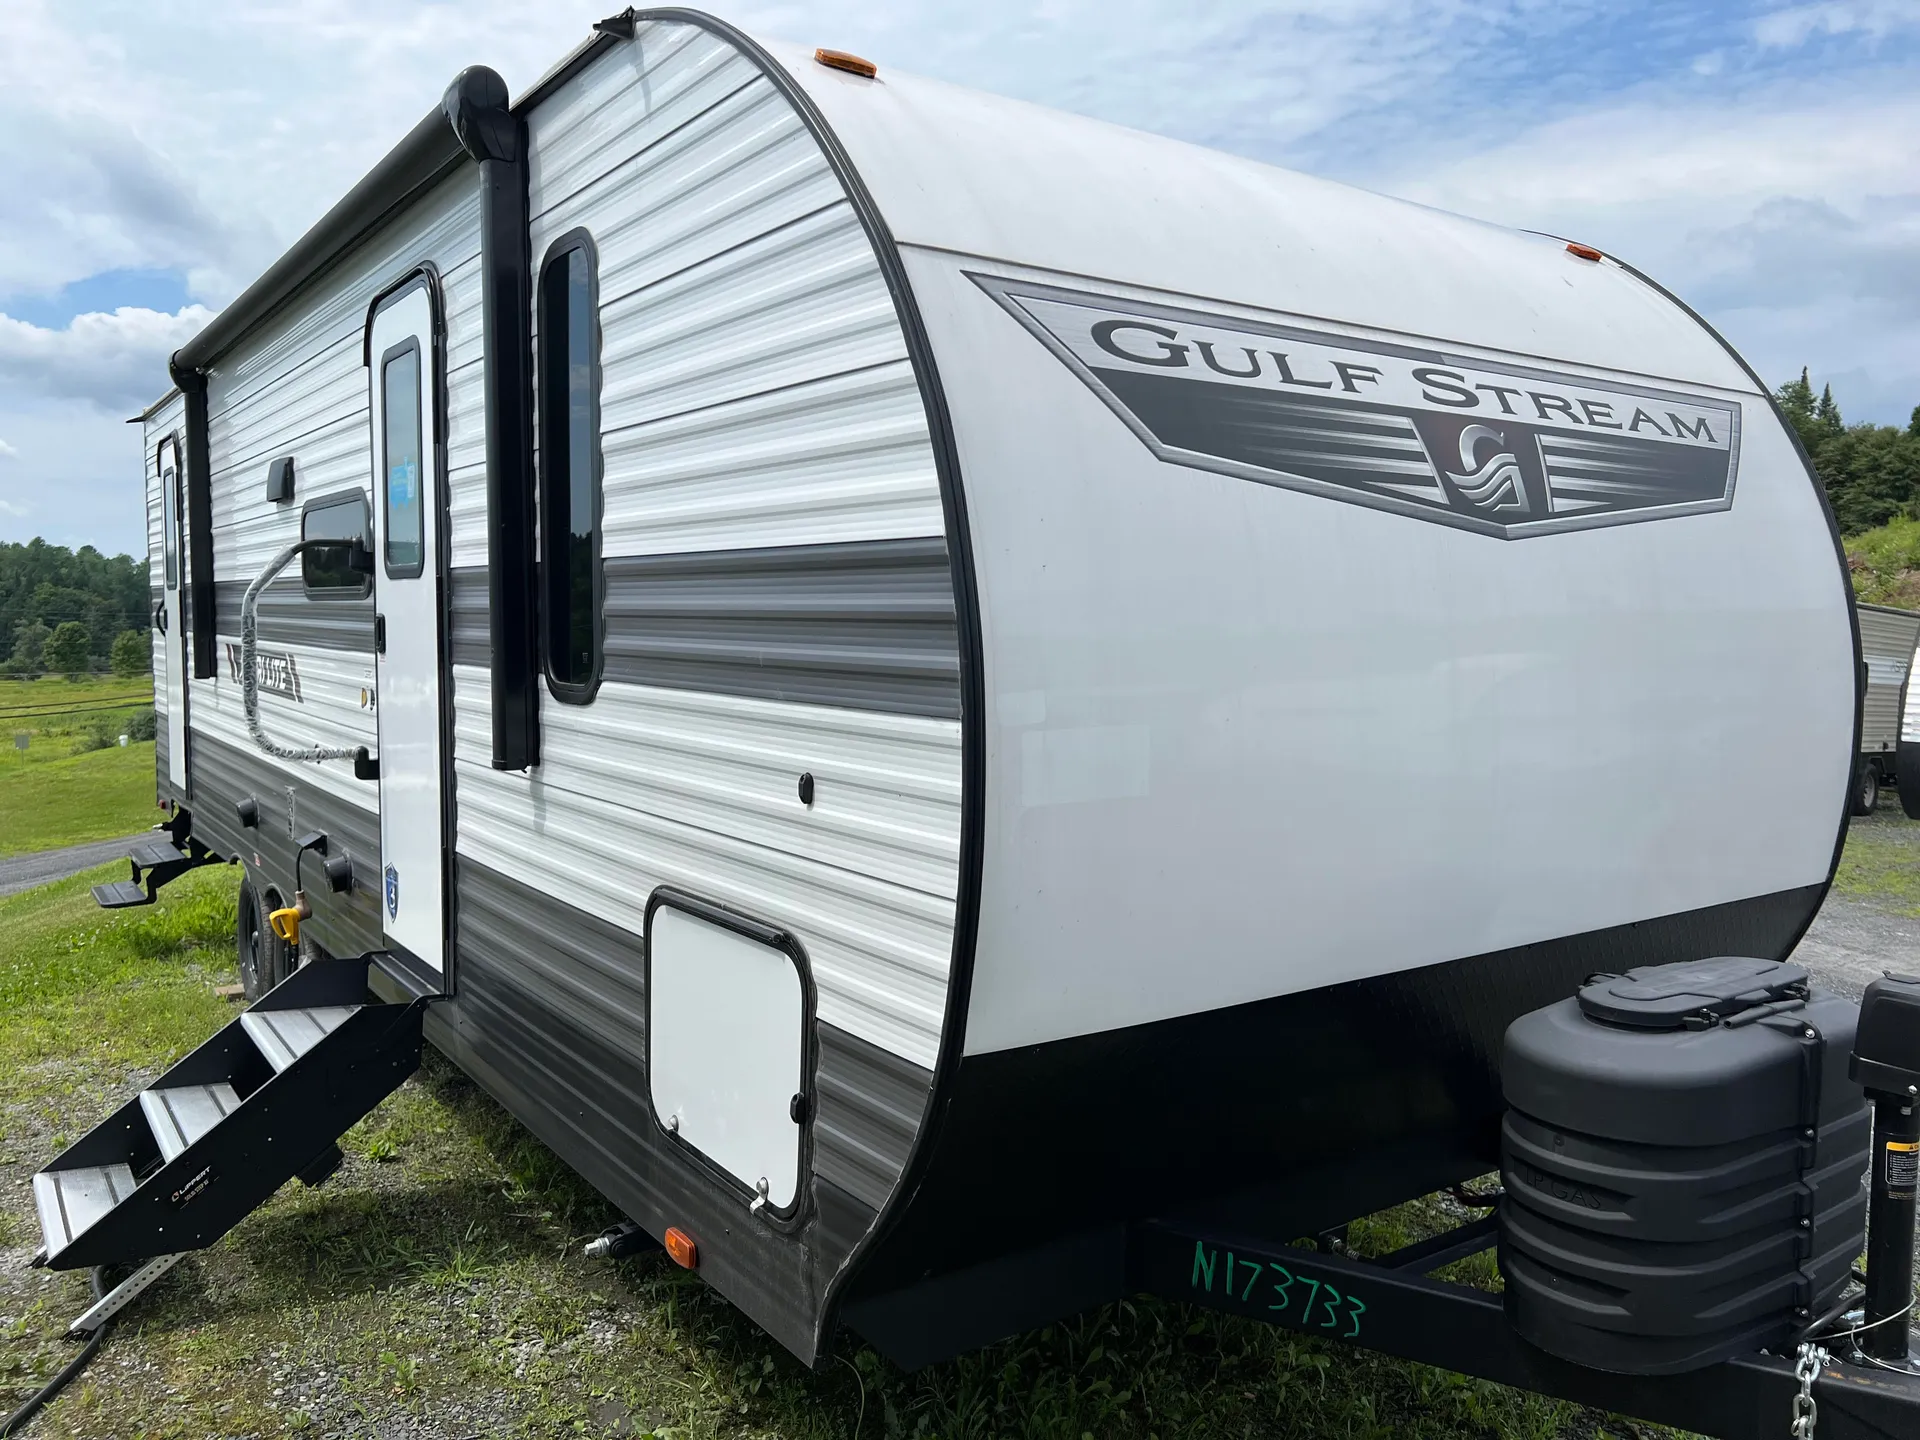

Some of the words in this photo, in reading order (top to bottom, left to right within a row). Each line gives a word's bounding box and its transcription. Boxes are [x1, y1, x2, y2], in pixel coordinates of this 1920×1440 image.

[1090, 319, 1384, 394] GULF
[1411, 367, 1719, 443] STREAM
[1526, 1166, 1543, 1188] LP
[1551, 1181, 1601, 1209] GAS
